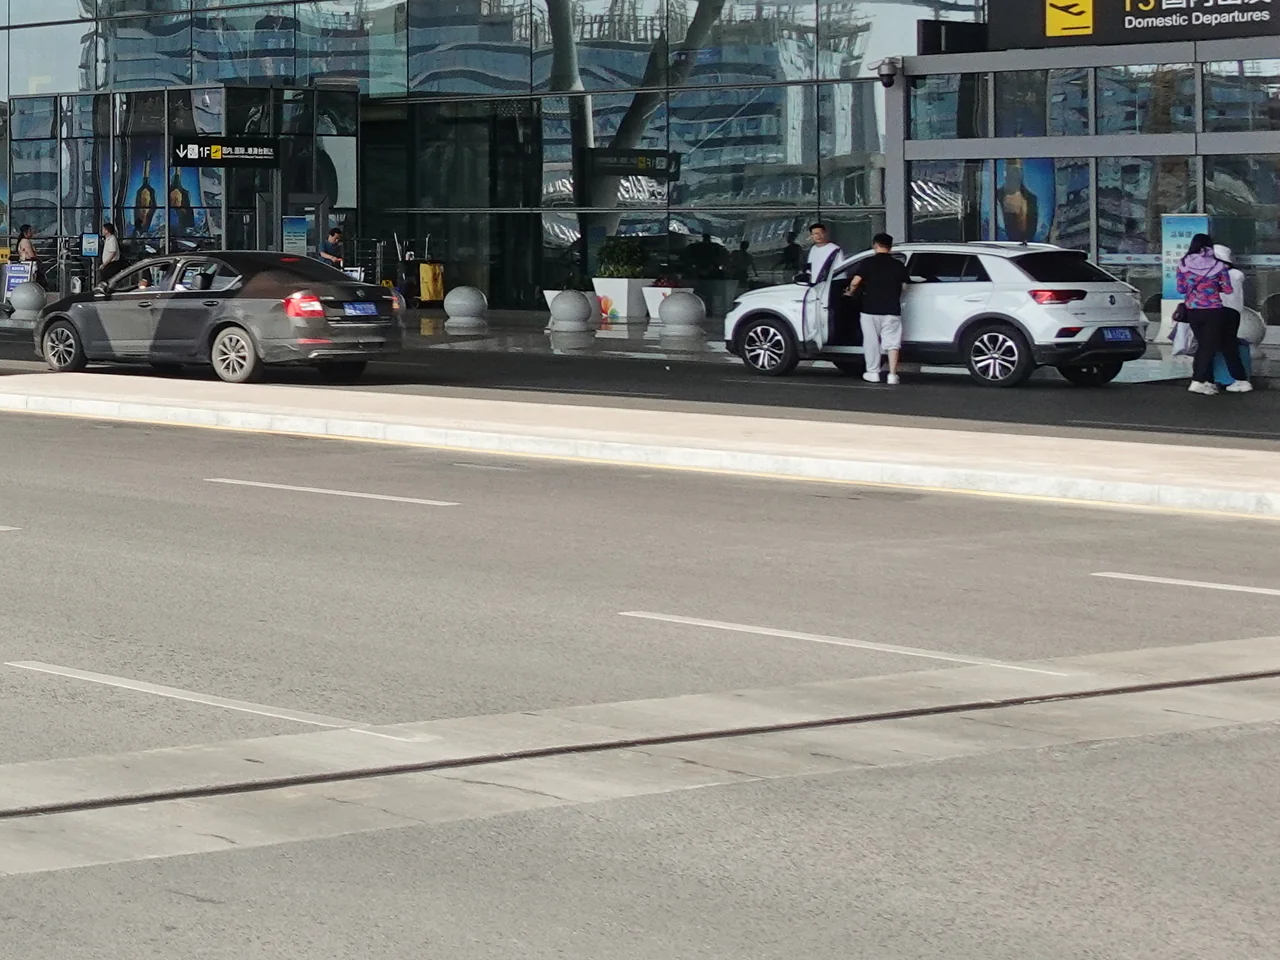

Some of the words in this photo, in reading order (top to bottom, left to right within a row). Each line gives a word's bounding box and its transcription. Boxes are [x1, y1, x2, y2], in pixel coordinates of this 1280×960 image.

[1124, 13, 1189, 29] Domestic
[1191, 10, 1271, 27] Departures
[199, 146, 211, 158] 1F
